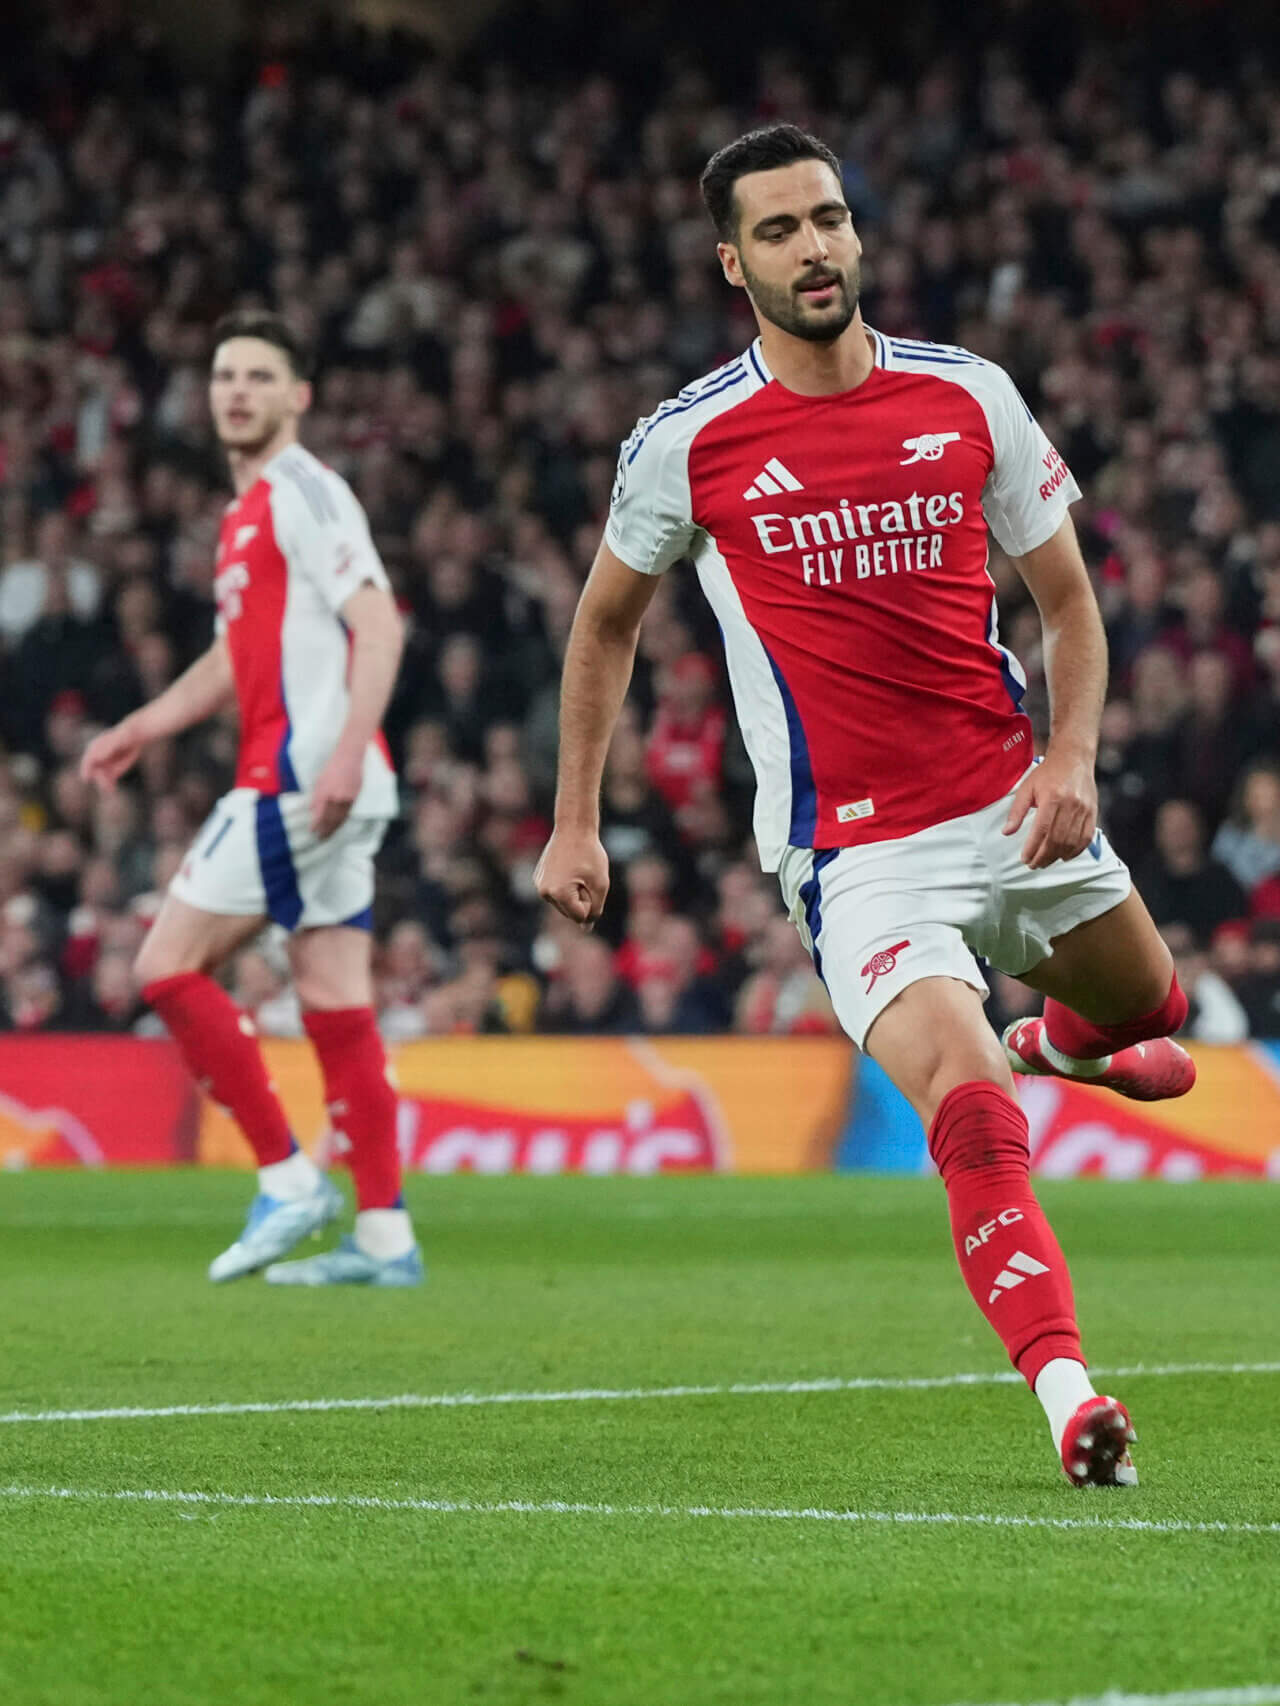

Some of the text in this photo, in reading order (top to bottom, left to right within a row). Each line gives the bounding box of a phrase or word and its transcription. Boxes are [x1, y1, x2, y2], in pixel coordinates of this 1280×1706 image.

[750, 490, 964, 555] Emirates
[802, 533, 943, 587] FLY BETTER
[965, 1207, 1024, 1256] AFC
